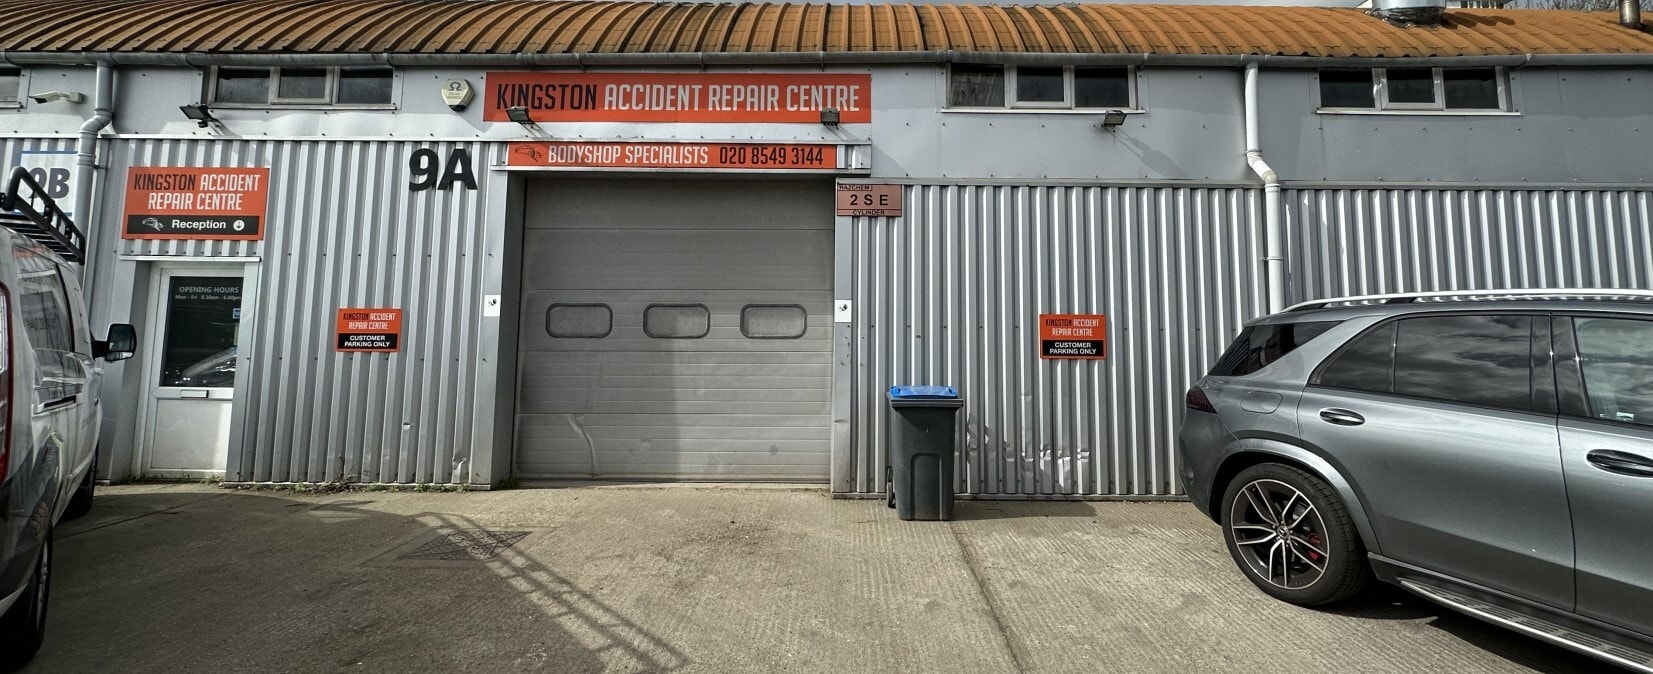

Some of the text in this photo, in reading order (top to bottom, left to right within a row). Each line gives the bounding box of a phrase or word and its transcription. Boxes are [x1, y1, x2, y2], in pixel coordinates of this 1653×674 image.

[496, 83, 860, 112] KINGSTON ACCIDENT REPAIR CENTRE
[548, 145, 824, 165] BODYSHOP SPECIALISTS 020 8549 3144
[409, 148, 478, 192] 9A
[134, 173, 261, 191] KINGSTON ACCIDENT
[148, 192, 243, 211] REPAIR CENTRE
[850, 194, 888, 206] 2 S E
[171, 219, 227, 231] Reception
[213, 286, 239, 294] HOURS
[343, 312, 396, 321] KINGSTON ACCIDENT
[1045, 318, 1099, 327] KINGSTON ACCIDENT
[348, 321, 389, 330] REPAIR CENTRE
[1051, 327, 1093, 337] REPAIR CENTRE
